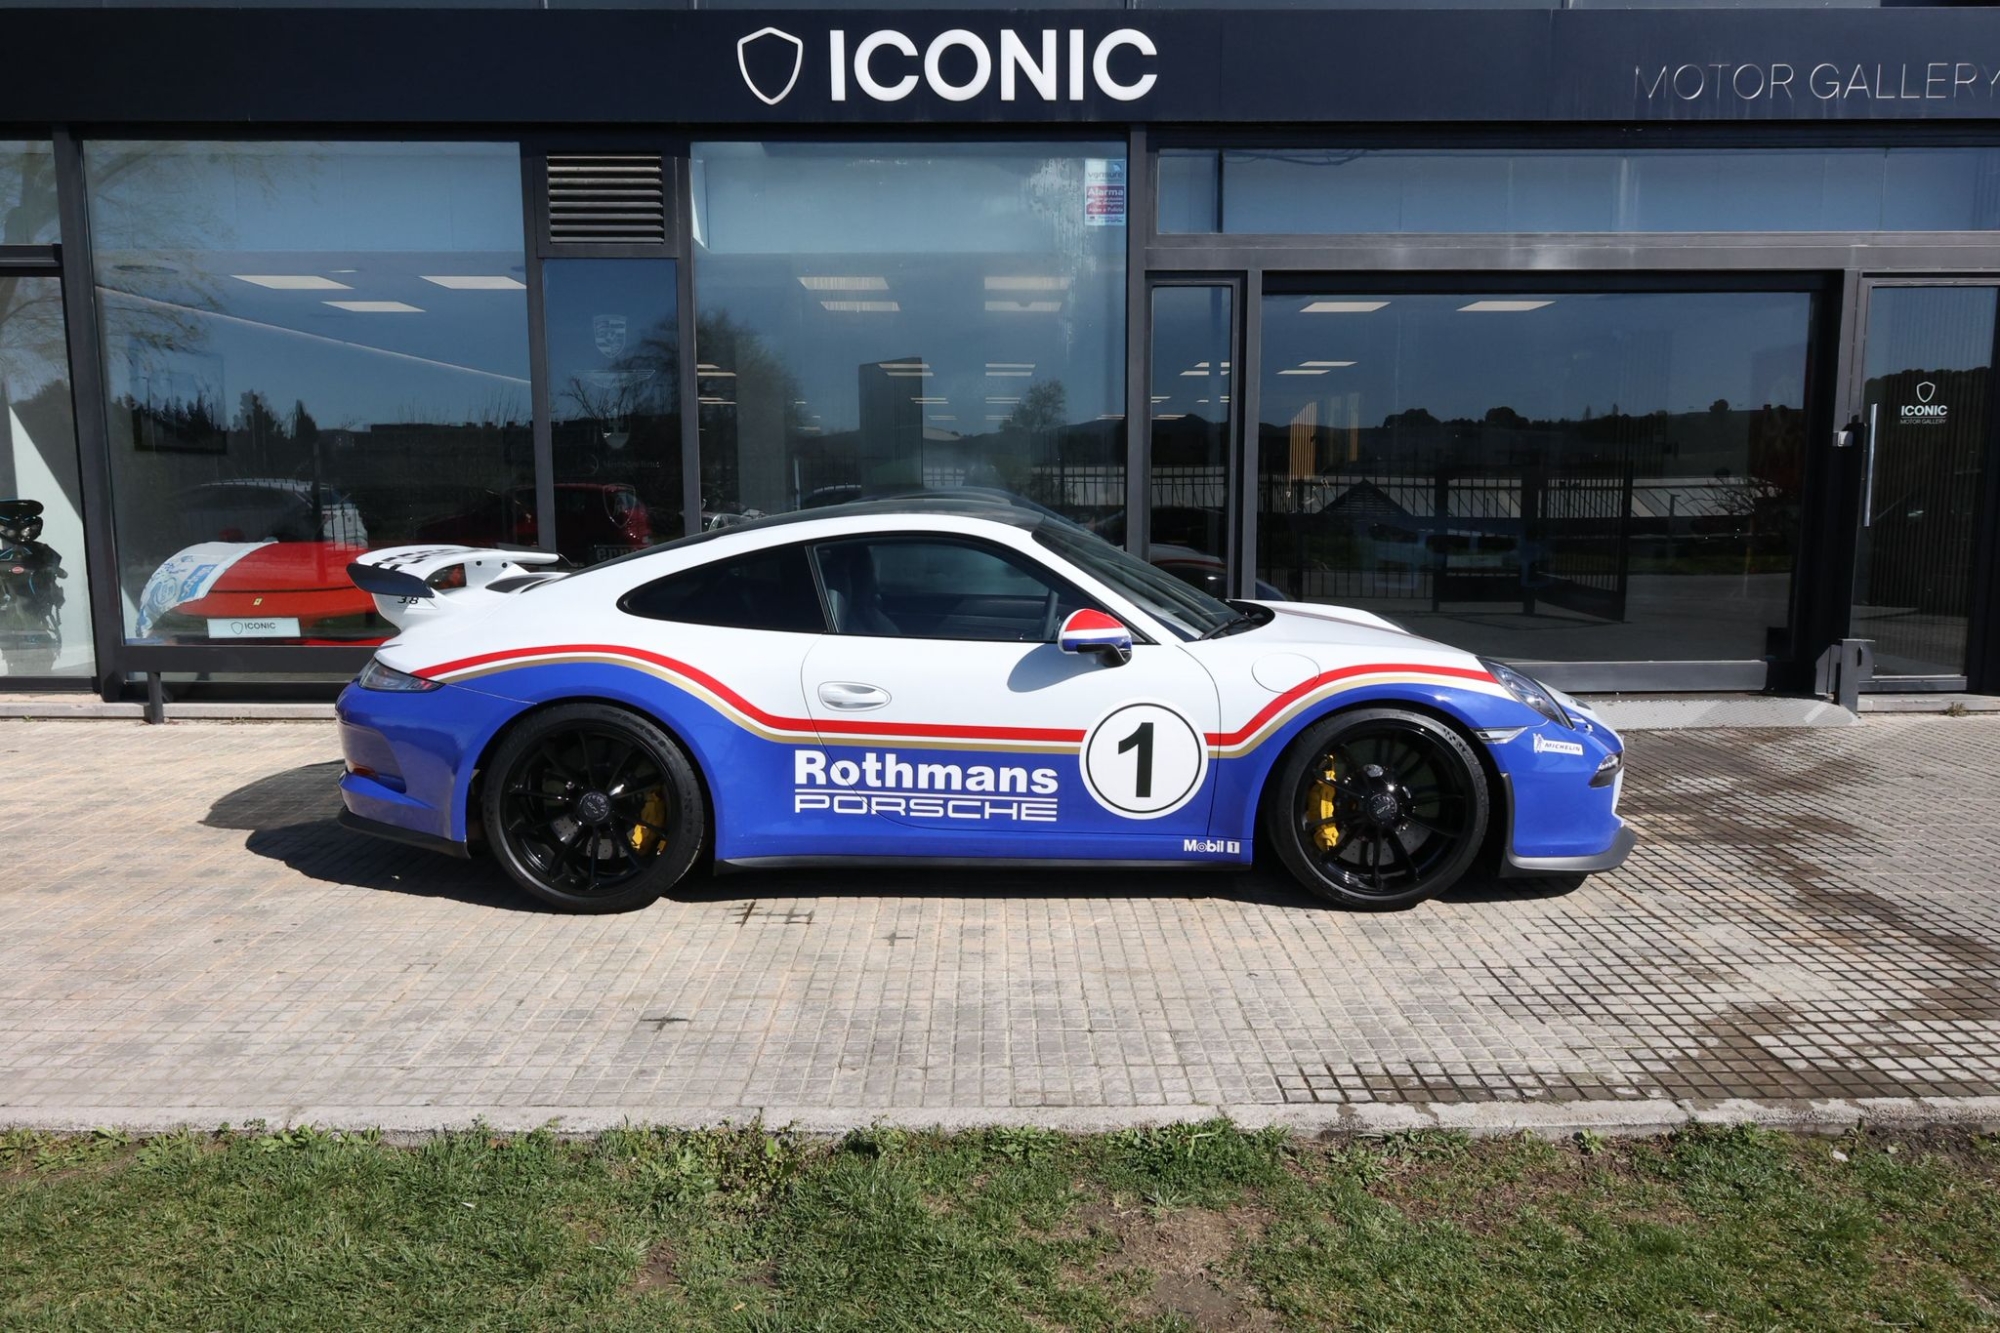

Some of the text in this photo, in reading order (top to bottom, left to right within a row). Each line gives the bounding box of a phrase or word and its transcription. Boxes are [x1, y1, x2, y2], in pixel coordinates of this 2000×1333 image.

[829, 28, 1158, 103] ICONIC
[1634, 63, 2000, 100] MOTOR GALLERY
[1087, 187, 1124, 196] Alarma
[1900, 405, 1948, 416] ICONIC
[244, 622, 276, 630] ICONIC
[1544, 742, 1581, 752] MICHELIN
[1117, 721, 1154, 798] 1
[795, 749, 1059, 794] Rothmans
[795, 795, 1058, 821] PORSCHE
[1183, 839, 1224, 853] Mobil
